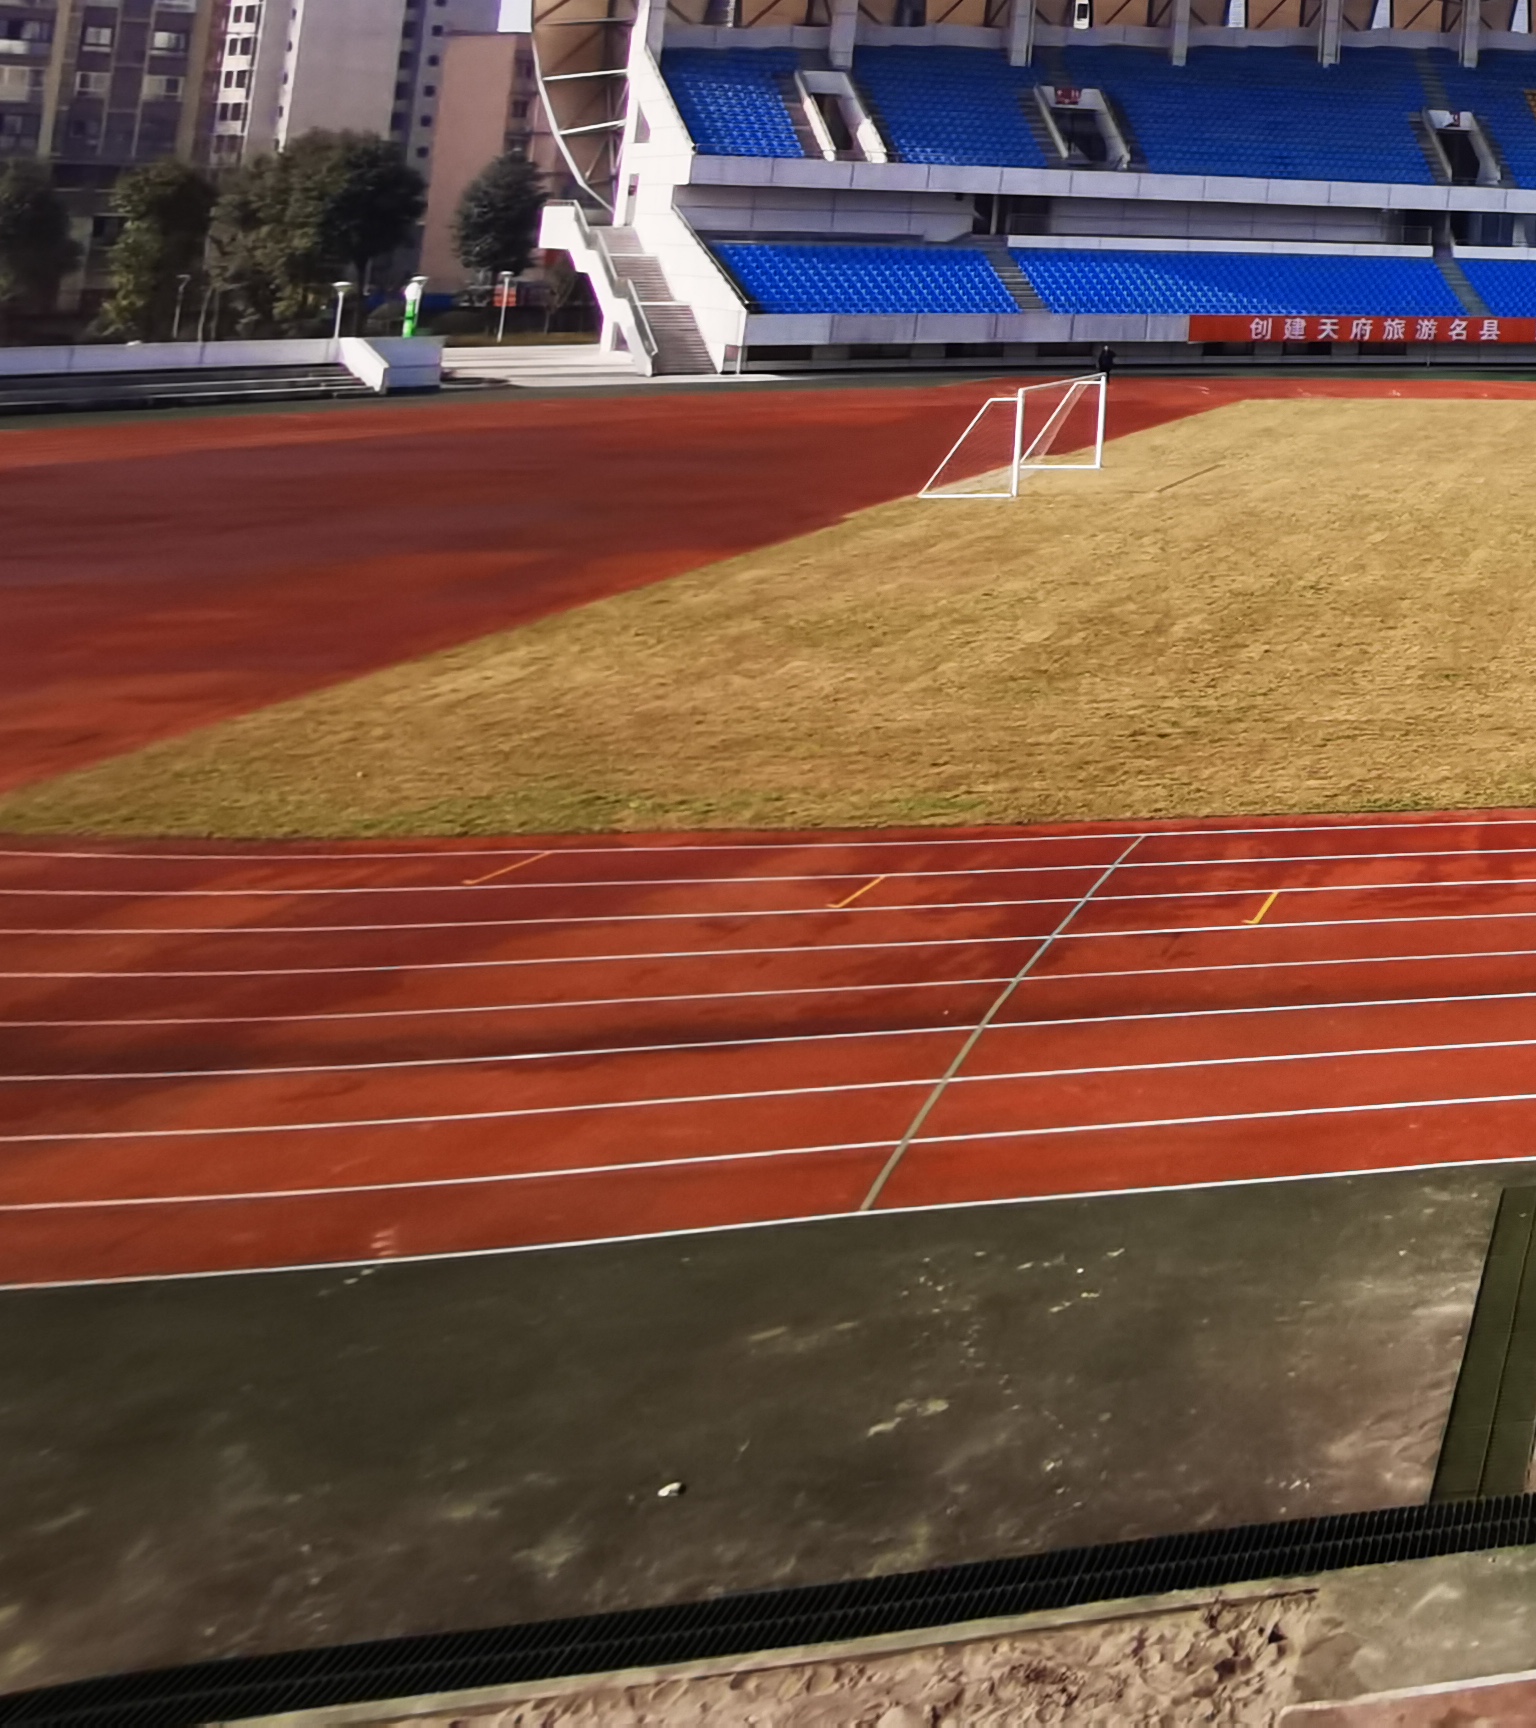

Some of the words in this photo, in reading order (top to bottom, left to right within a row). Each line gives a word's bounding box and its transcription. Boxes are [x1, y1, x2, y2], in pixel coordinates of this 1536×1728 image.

[1249, 317, 1502, 342] 创建天府旅游名县
